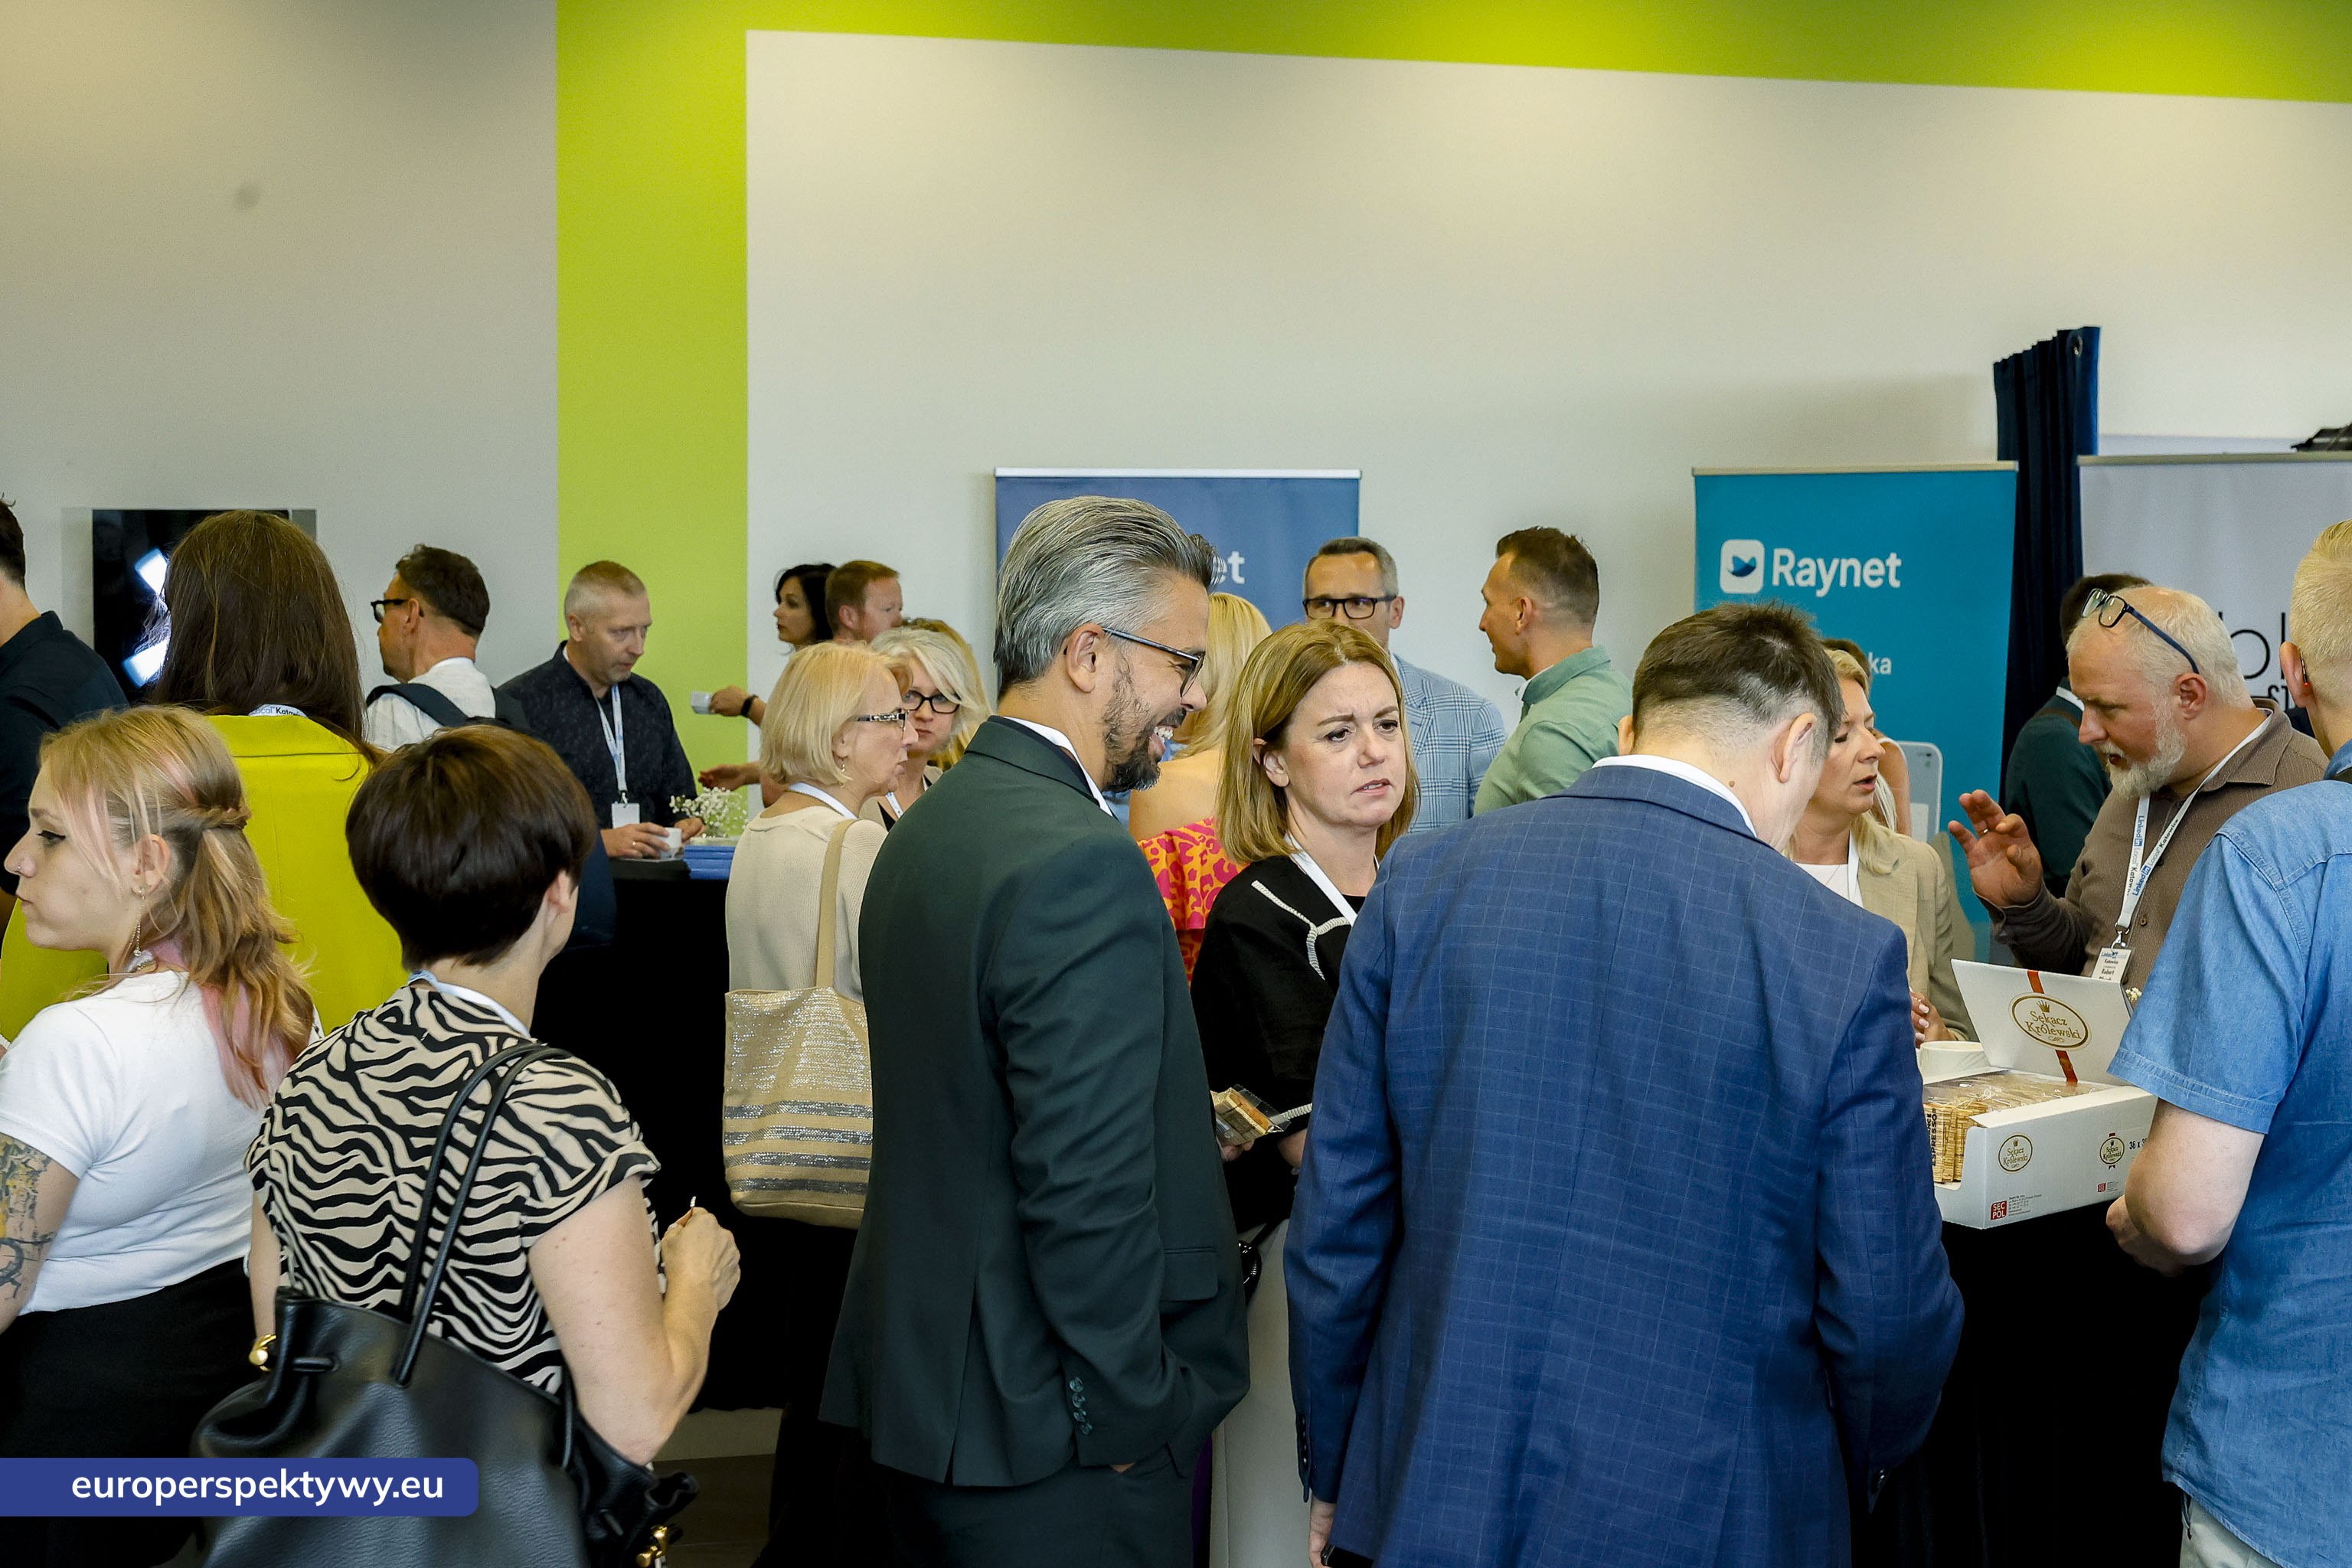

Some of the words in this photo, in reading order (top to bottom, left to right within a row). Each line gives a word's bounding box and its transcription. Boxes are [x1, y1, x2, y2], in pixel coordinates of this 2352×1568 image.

[1210, 550, 1246, 584] et
[1772, 548, 1902, 597] Raynet
[1868, 652, 1892, 675] ka
[2030, 1011, 2067, 1027] Sękacz
[2024, 1021, 2082, 1040] Królewski
[2129, 1140, 2136, 1150] 36
[1992, 1210, 2005, 1220] POL
[1993, 1202, 2006, 1211] SEC
